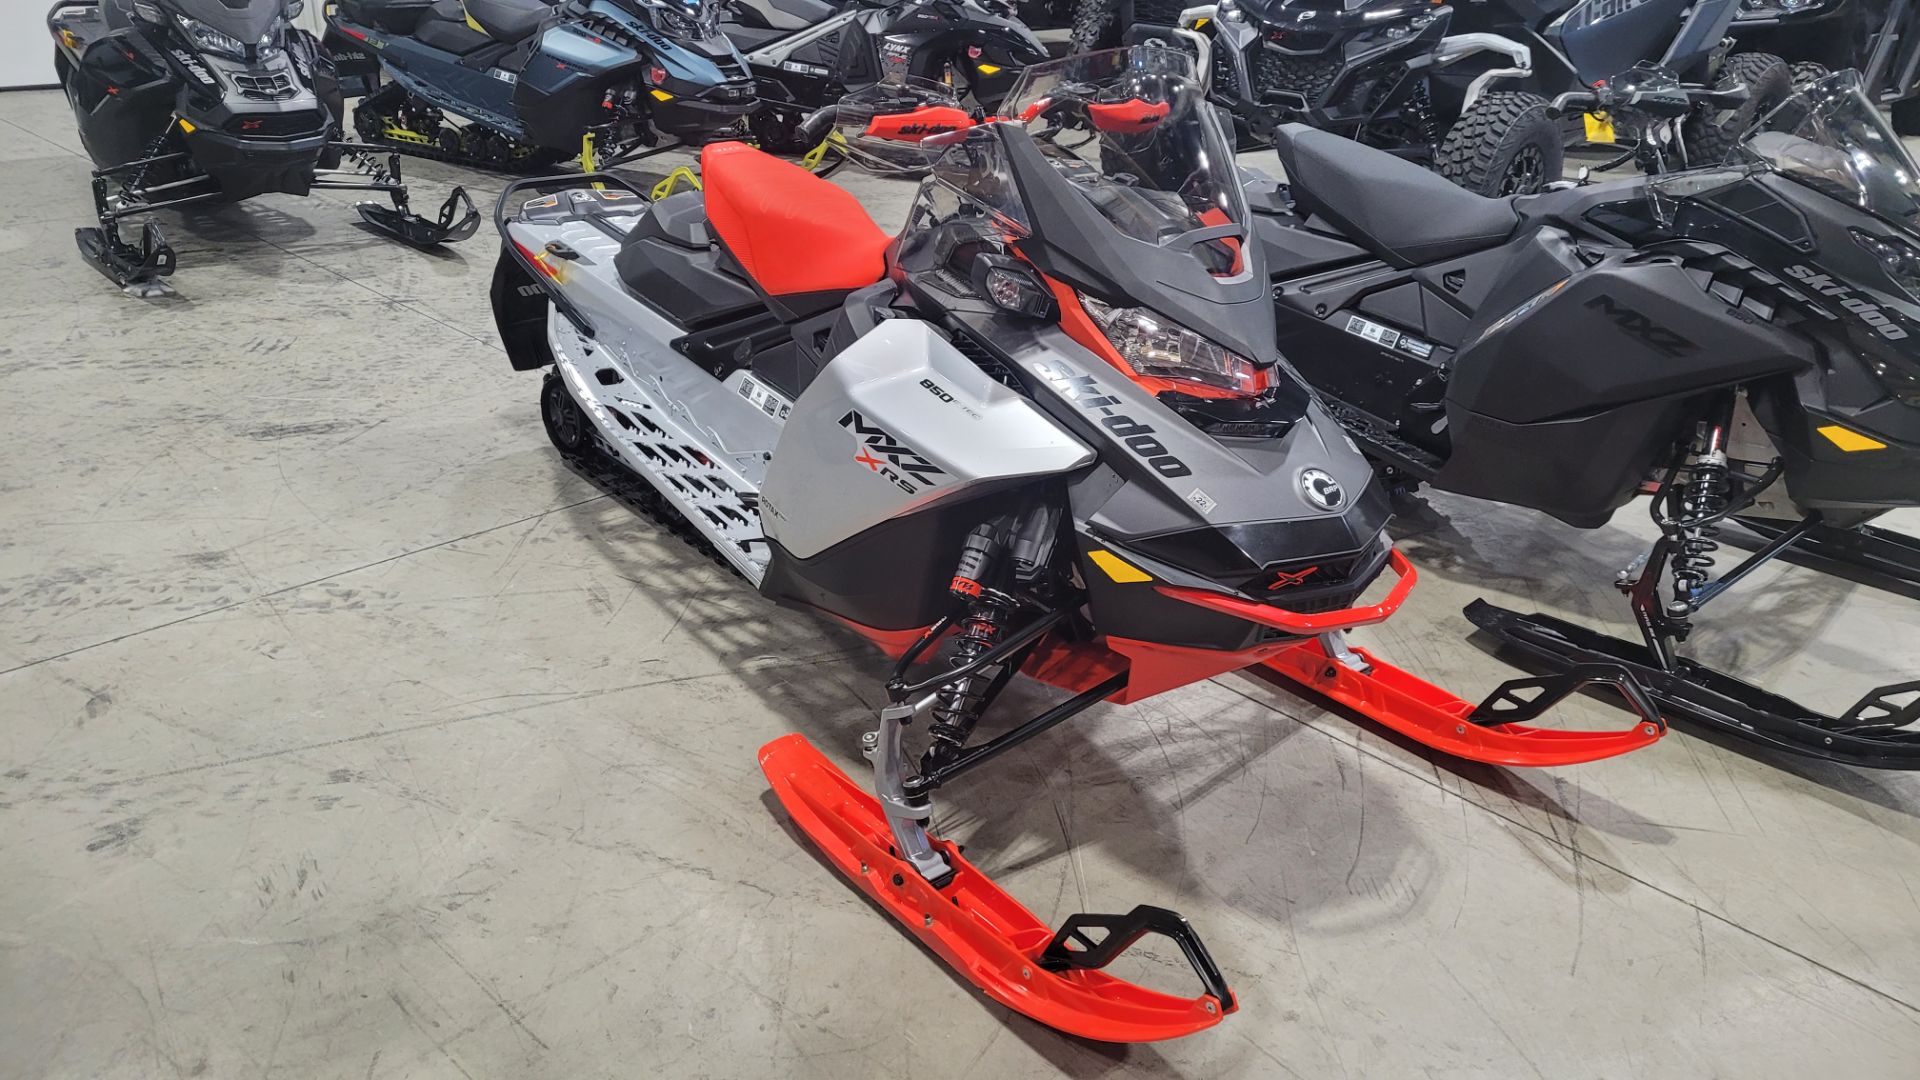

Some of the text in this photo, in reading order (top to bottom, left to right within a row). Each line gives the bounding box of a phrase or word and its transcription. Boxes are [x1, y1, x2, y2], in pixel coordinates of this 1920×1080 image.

[625, 20, 673, 51] ski-doo
[883, 43, 911, 54] LYNX
[170, 49, 216, 85] ski-doo
[1783, 264, 1909, 340] ski-doo
[1584, 294, 1706, 358] MXZ
[919, 378, 954, 403] 850
[1032, 359, 1193, 479] ski-doo
[838, 408, 948, 487] MXZ
[1323, 485, 1338, 495] BRP
